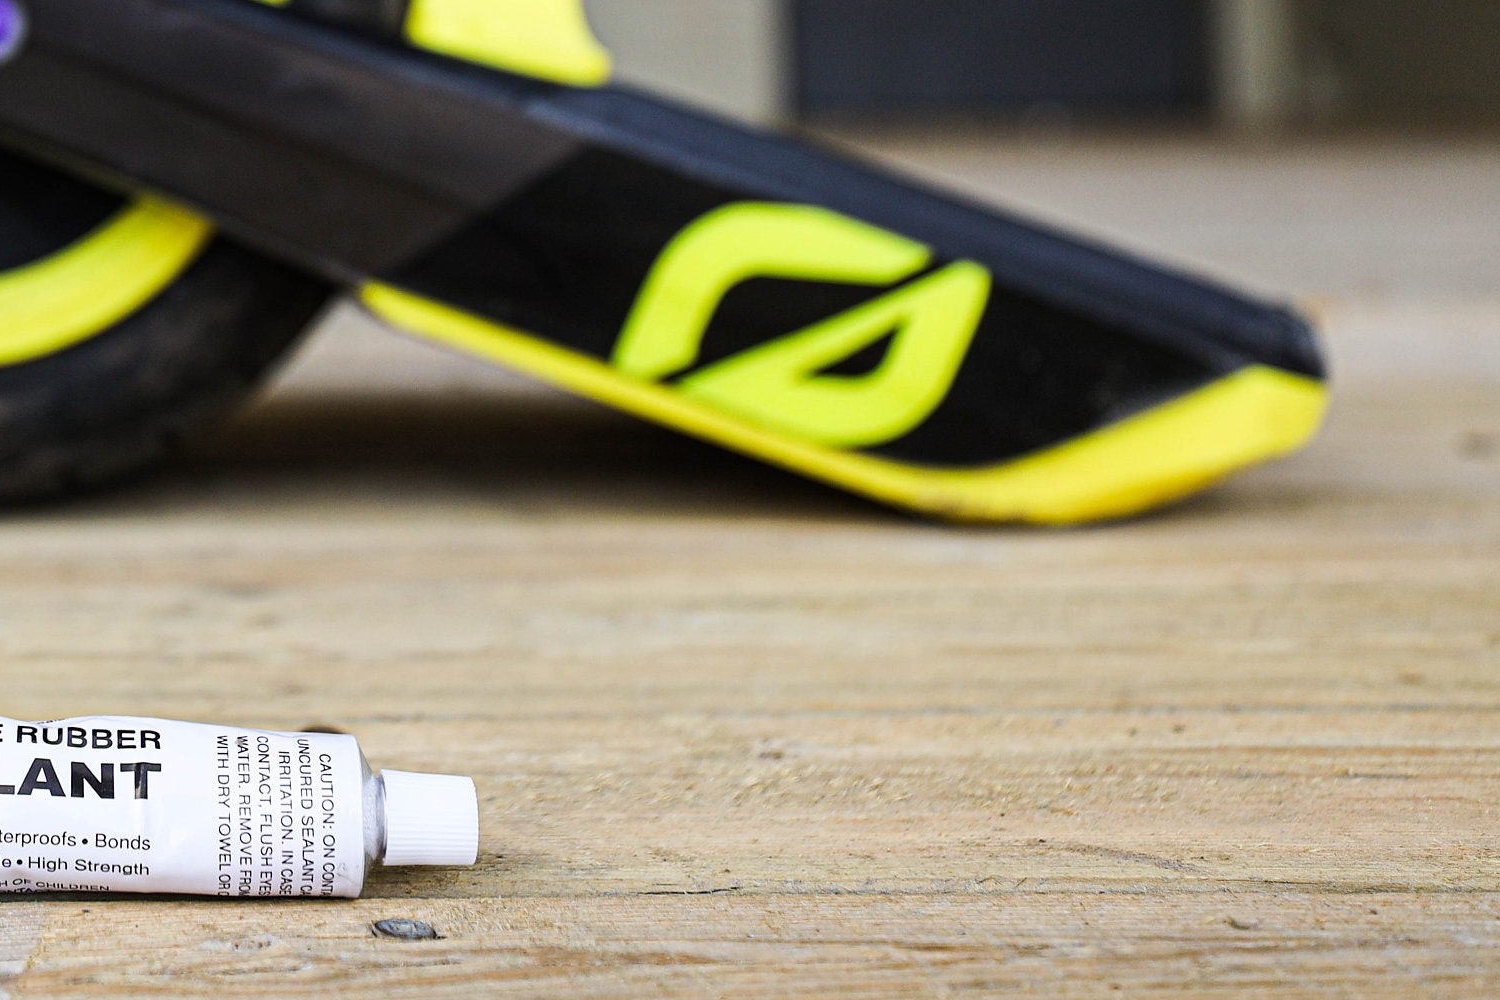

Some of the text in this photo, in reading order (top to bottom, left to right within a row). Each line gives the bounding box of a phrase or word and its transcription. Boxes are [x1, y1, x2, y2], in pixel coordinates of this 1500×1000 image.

[16, 725, 161, 749] RUBBER
[217, 736, 229, 768] WITH
[237, 736, 250, 788] WATER.
[297, 739, 313, 809] UNCURED
[218, 774, 230, 808] DRY
[319, 754, 334, 829] CAUTION:
[239, 794, 252, 865] REMOVE
[257, 736, 273, 895] CONTACT, FLUSH EYES
[279, 751, 293, 895] IRRITATION. IN CASE
[95, 833, 151, 850] Bonds
[219, 814, 231, 870] TOWEL
[302, 815, 314, 882] SEALANT
[323, 835, 335, 857] ON
[28, 856, 67, 872] High
[75, 859, 149, 876] Strength
[36, 881, 109, 891] CHILDREN
[219, 874, 230, 889] OR
